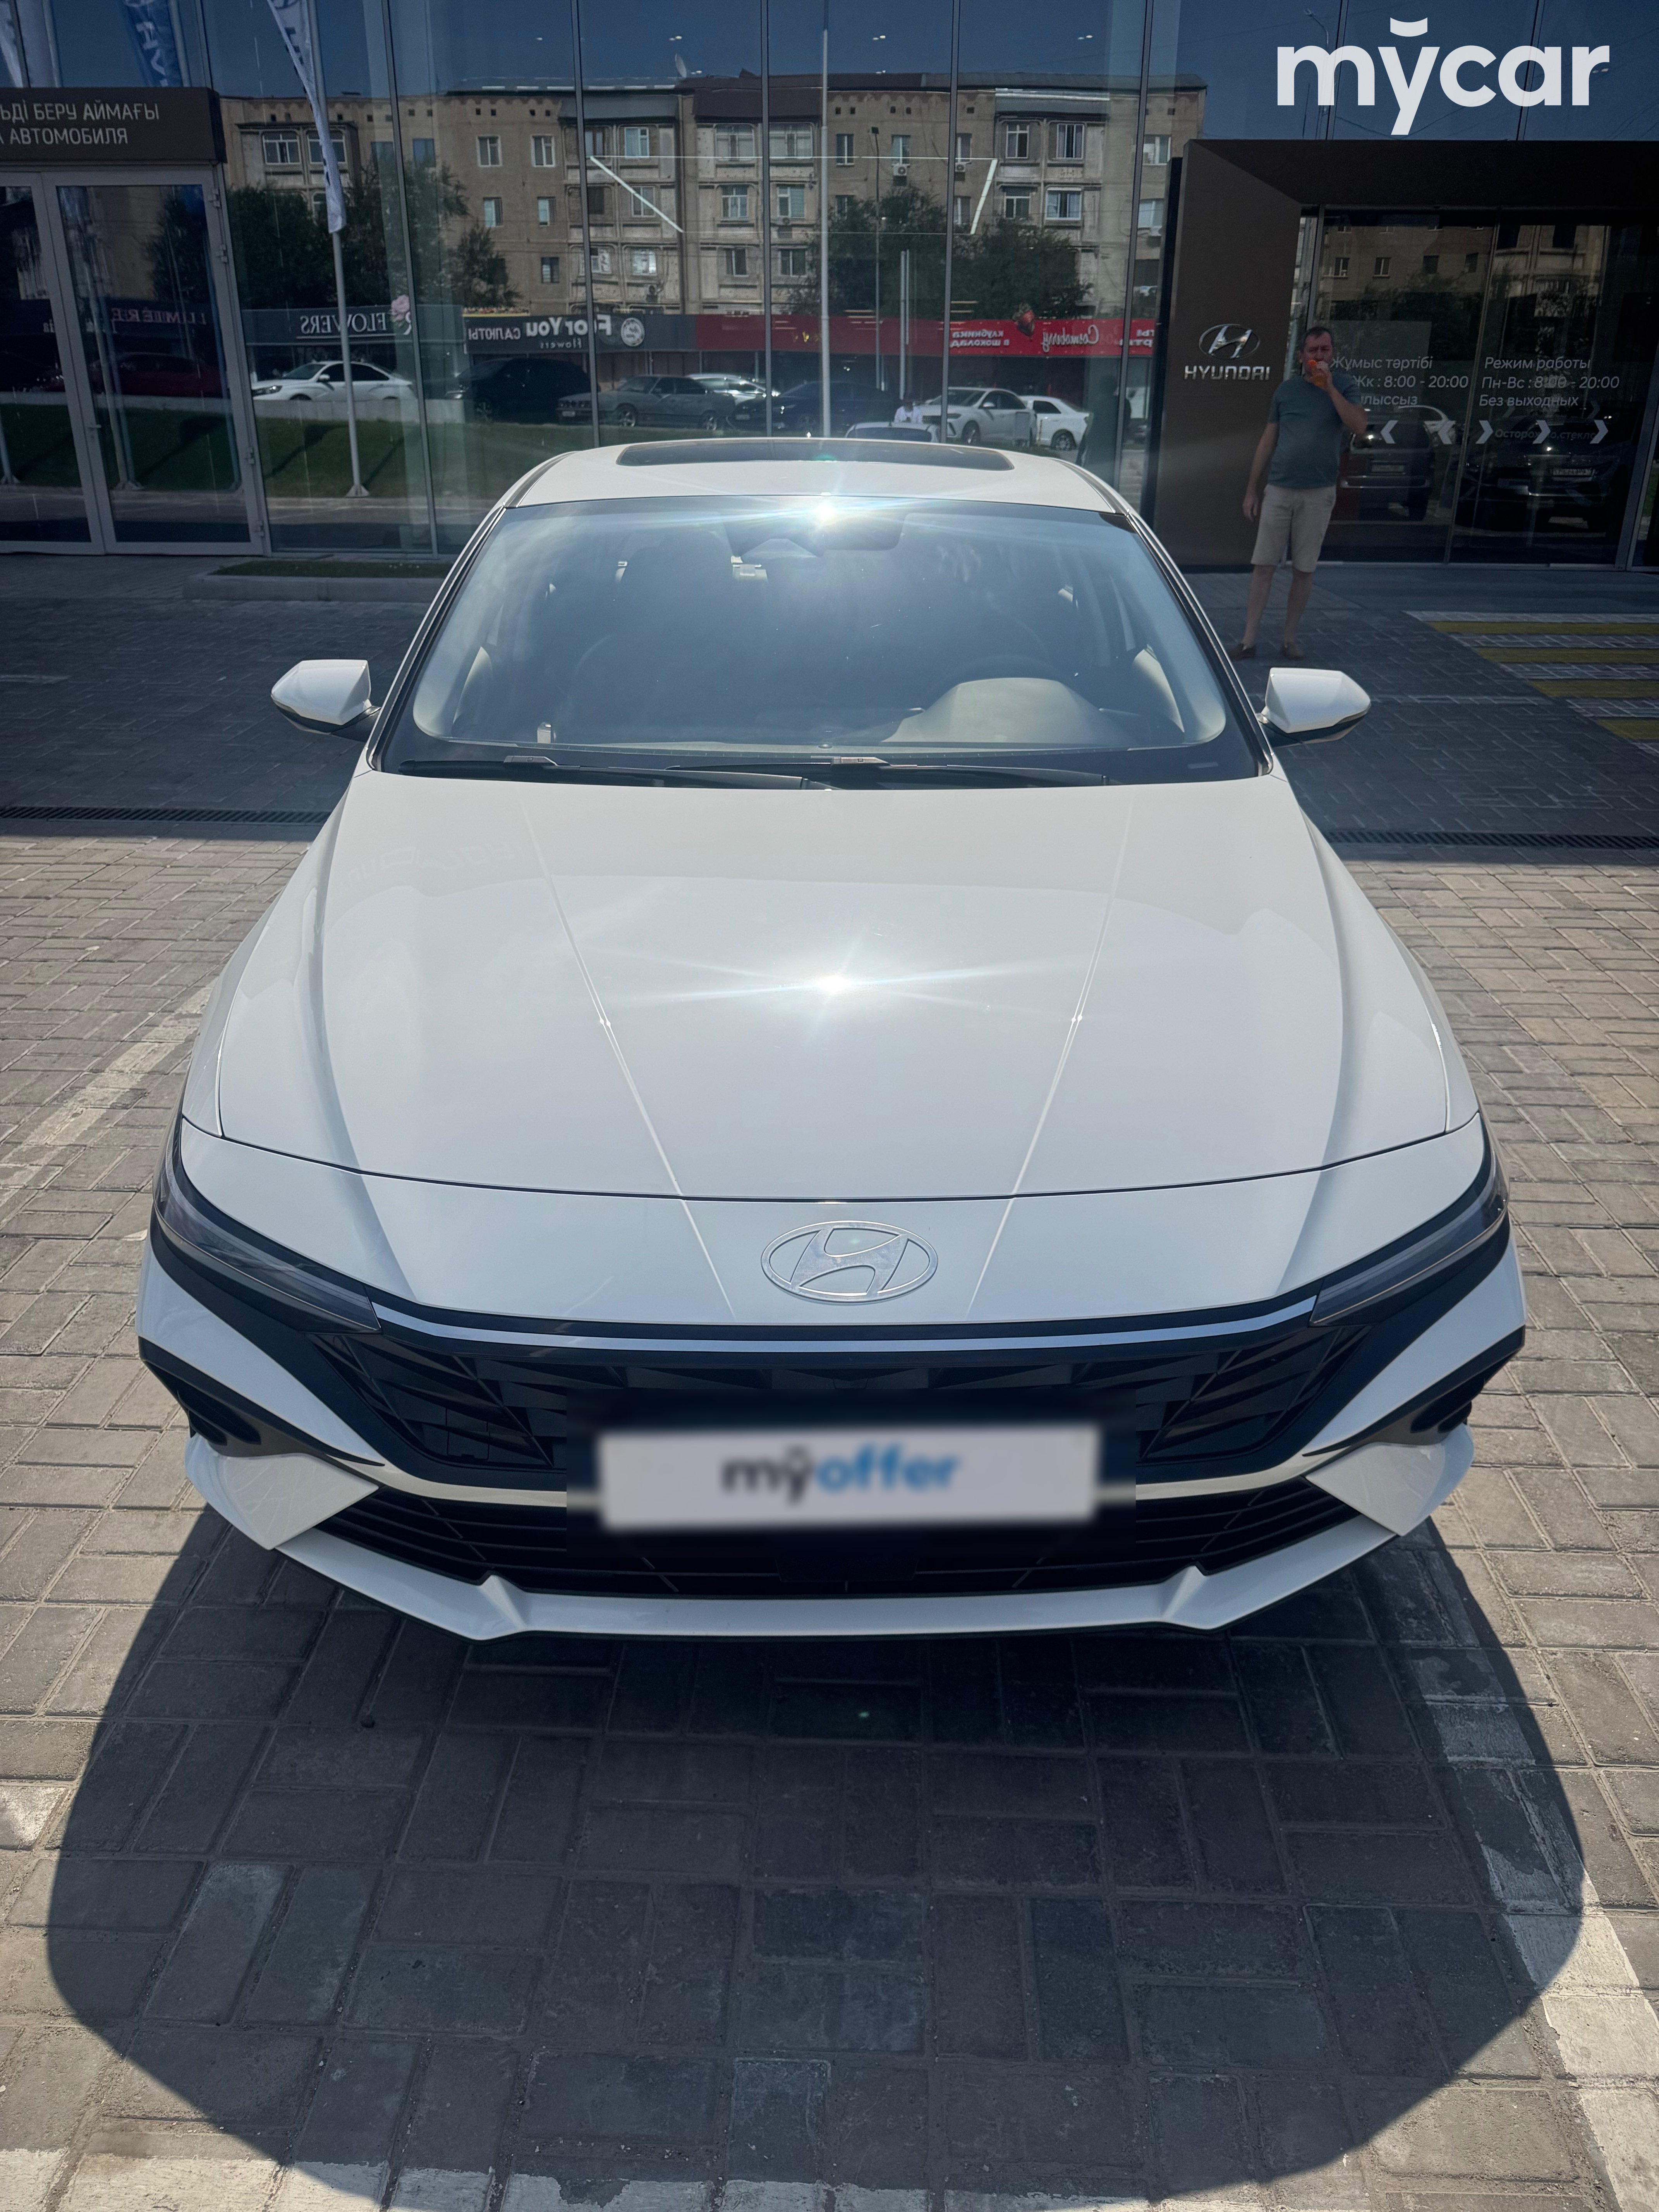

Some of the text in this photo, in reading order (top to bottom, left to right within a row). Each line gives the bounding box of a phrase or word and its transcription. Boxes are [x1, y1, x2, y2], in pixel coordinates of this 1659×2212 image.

[33, 103, 77, 120] БЕРУ
[82, 100, 160, 120] АЙМАҒЫ
[10, 128, 128, 144] АВТОМОБИЛЯ
[1386, 356, 1434, 371] тәртібі
[1485, 356, 1591, 371] Режим работы
[1184, 365, 1270, 380] HYUNDAI
[1384, 375, 1416, 388] 8:00
[1428, 375, 1469, 388] 20:00
[1482, 377, 1525, 388] Пн-Вс
[1579, 376, 1620, 388] 20:00
[1479, 394, 1579, 409] Без выходных
